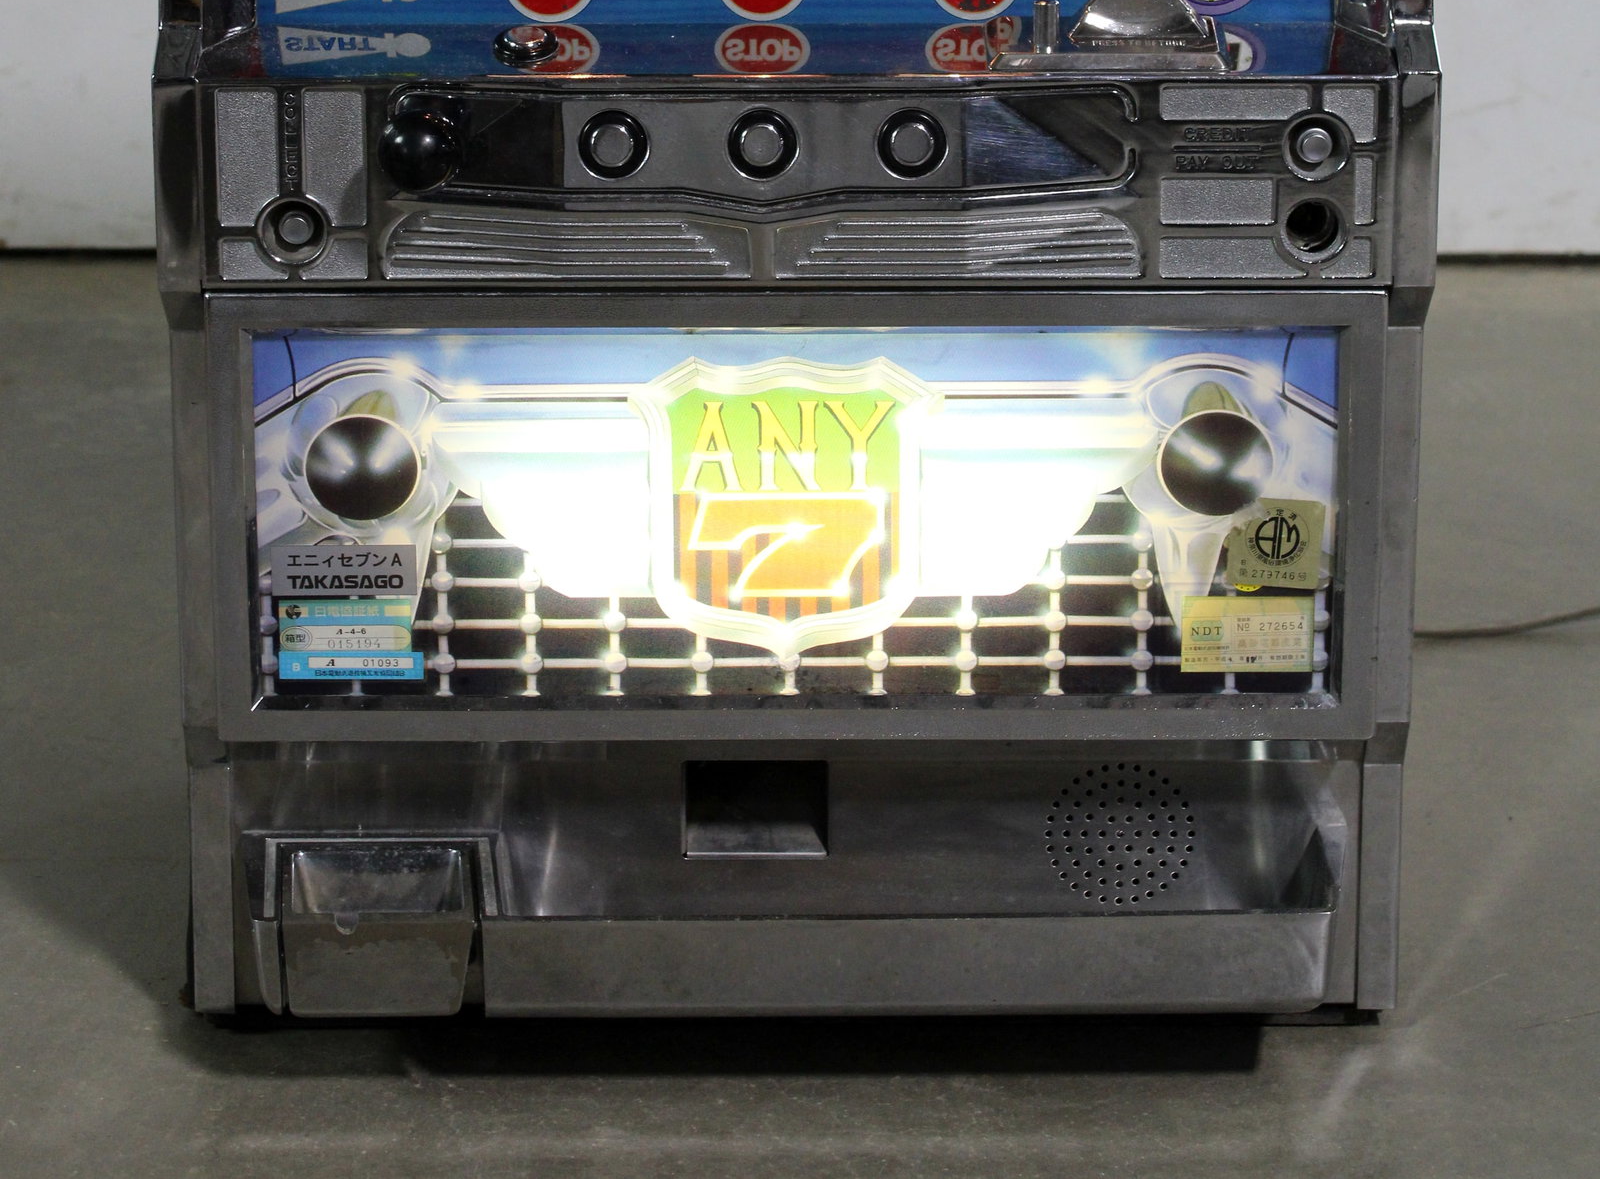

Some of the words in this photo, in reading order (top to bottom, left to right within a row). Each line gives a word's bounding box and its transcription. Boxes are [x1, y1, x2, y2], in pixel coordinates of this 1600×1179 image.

[1184, 128, 1252, 142] CREDIT
[1175, 156, 1209, 170] PAY
[1223, 155, 1260, 170] OUT
[680, 400, 897, 491] ANY
[688, 490, 886, 600] 7
[287, 574, 404, 589] TAKASAGO
[326, 658, 336, 666] A
[362, 658, 399, 667] 01093
